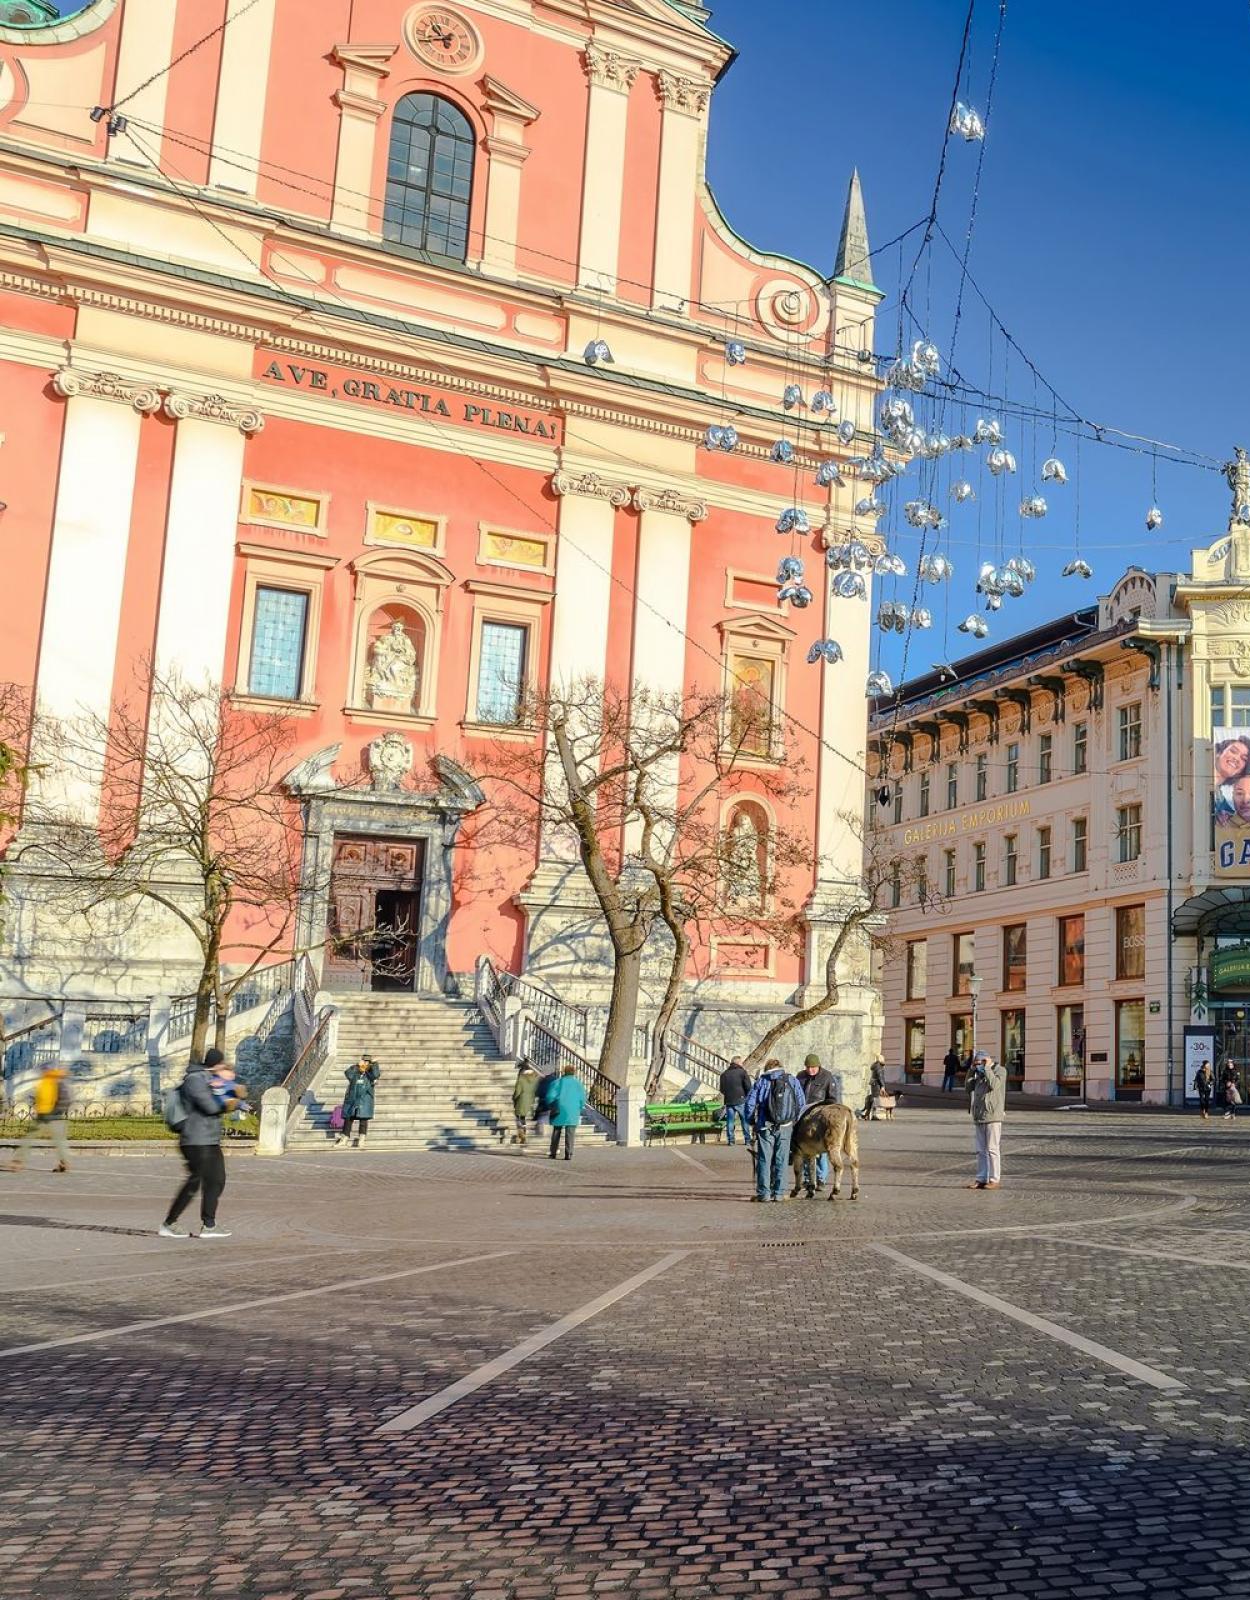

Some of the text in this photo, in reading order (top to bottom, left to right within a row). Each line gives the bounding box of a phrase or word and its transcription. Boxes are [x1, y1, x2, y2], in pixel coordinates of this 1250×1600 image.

[343, 378, 451, 416] GRATIA
[463, 403, 557, 439] PLENA!
[904, 800, 1031, 845] GALERIJA EMPORIUM
